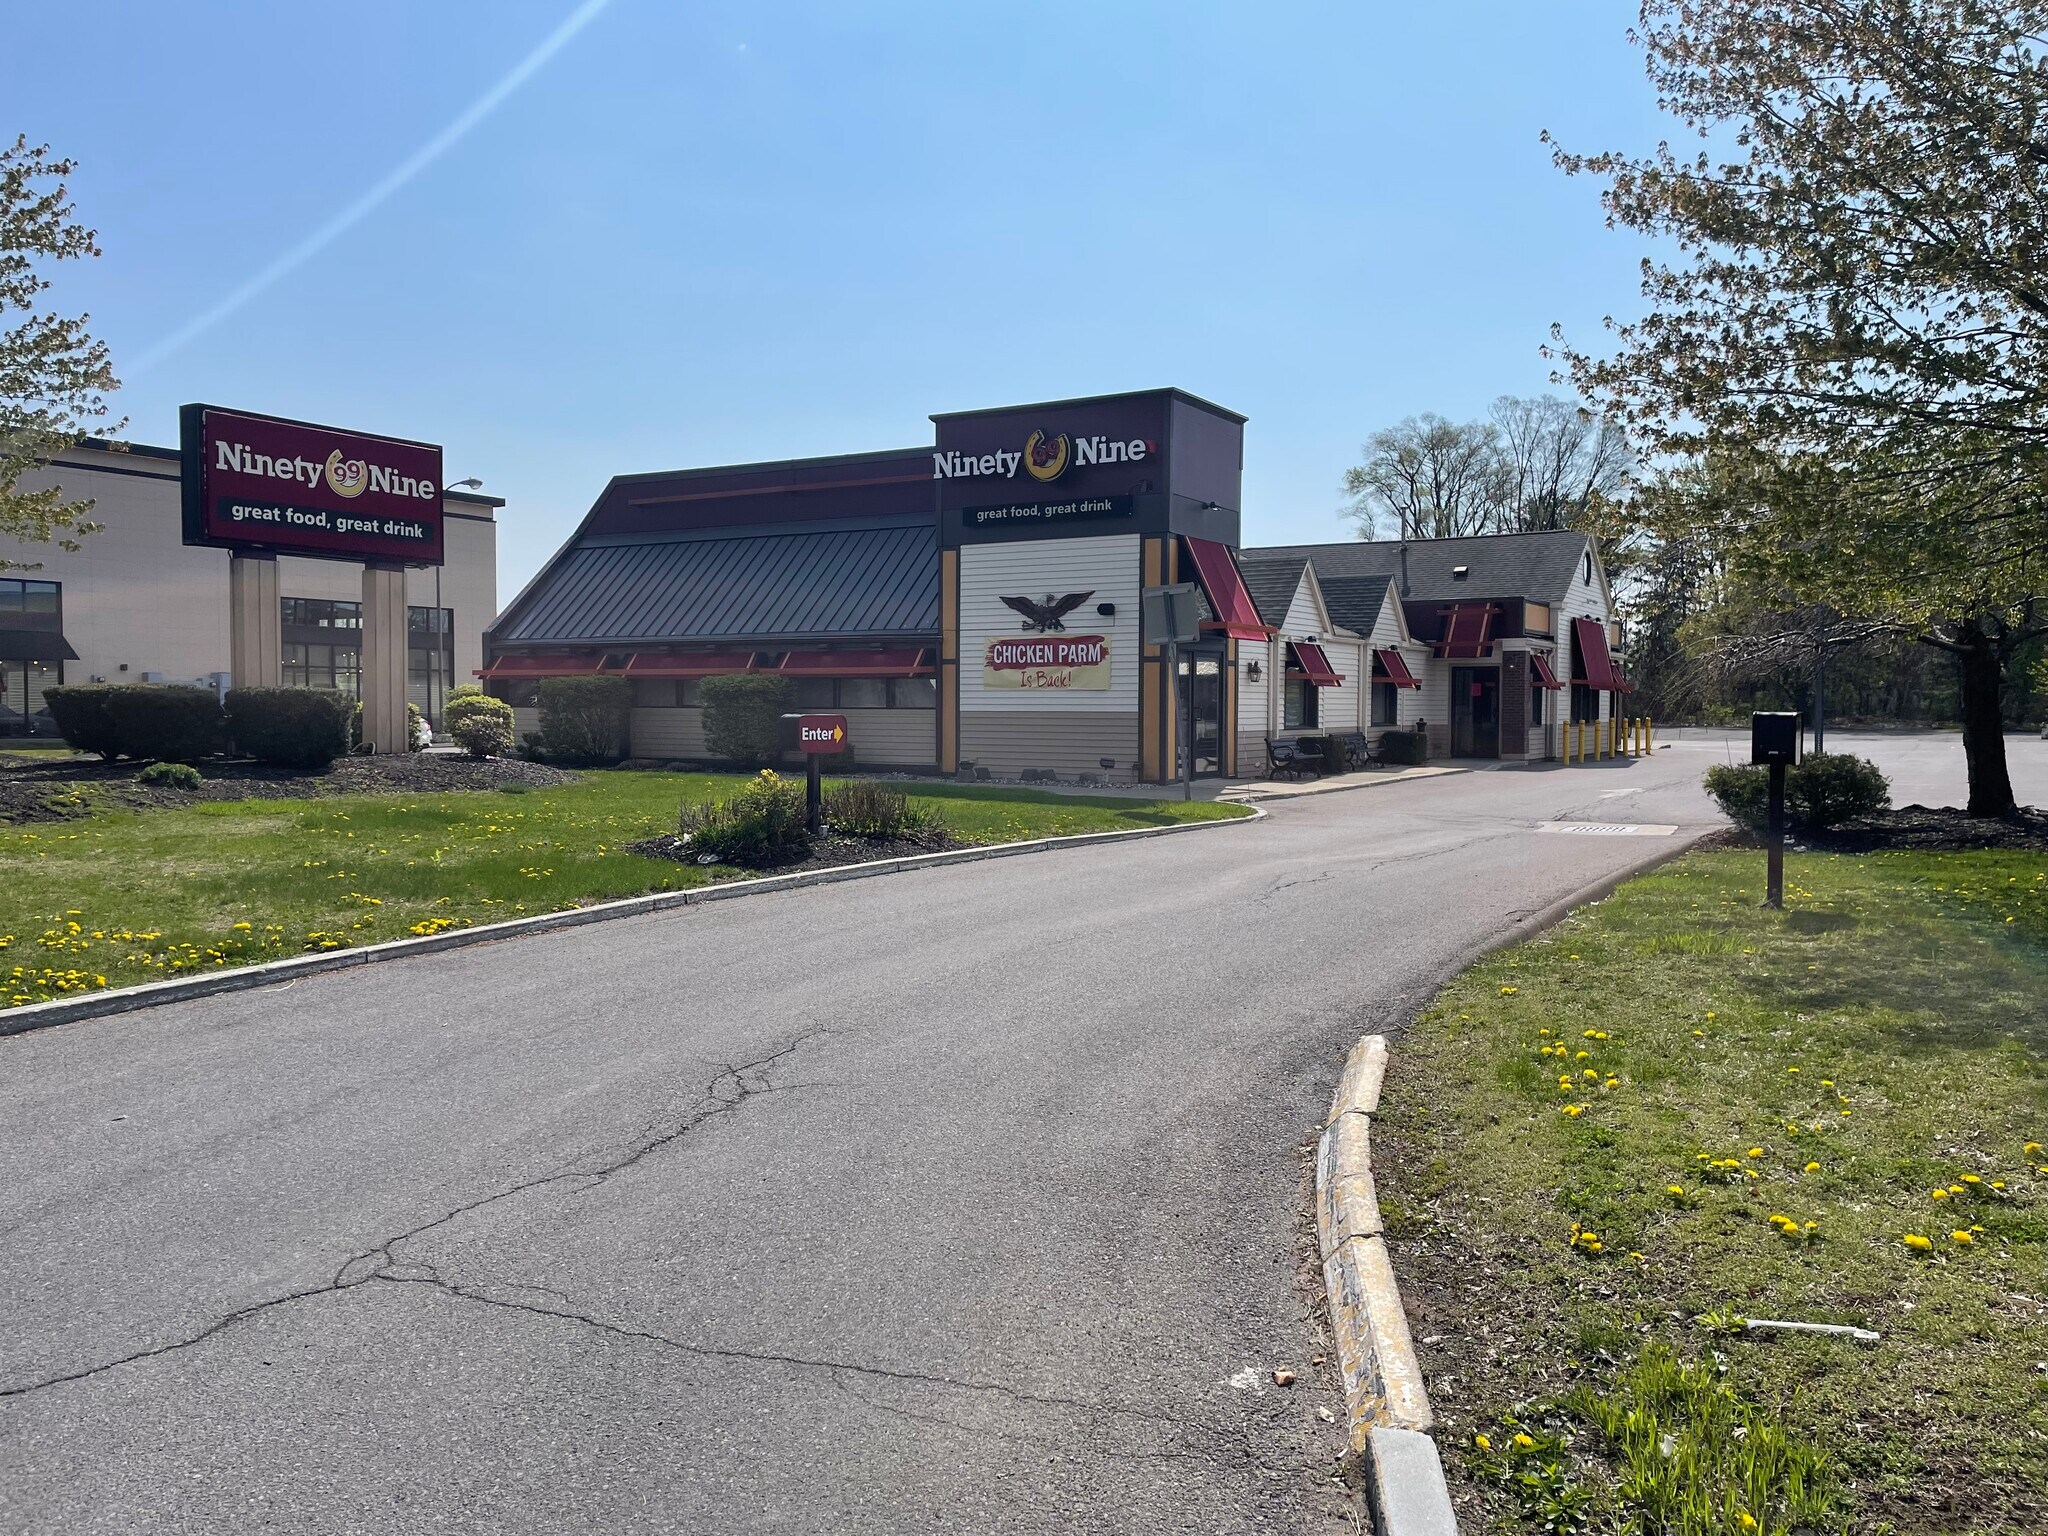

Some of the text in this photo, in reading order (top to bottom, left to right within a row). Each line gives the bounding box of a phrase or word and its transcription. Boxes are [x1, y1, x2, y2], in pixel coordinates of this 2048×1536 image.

[932, 448, 1022, 479] Ninety
[1075, 435, 1147, 466] Nine
[215, 440, 324, 489] Ninety
[368, 464, 435, 500] Nine
[231, 503, 423, 538] great food, great drink
[976, 499, 1112, 522] great food, great drink
[993, 643, 1101, 664] CHICKEN PARM
[1020, 670, 1072, 687] Is Back!
[802, 727, 834, 741] Enter
